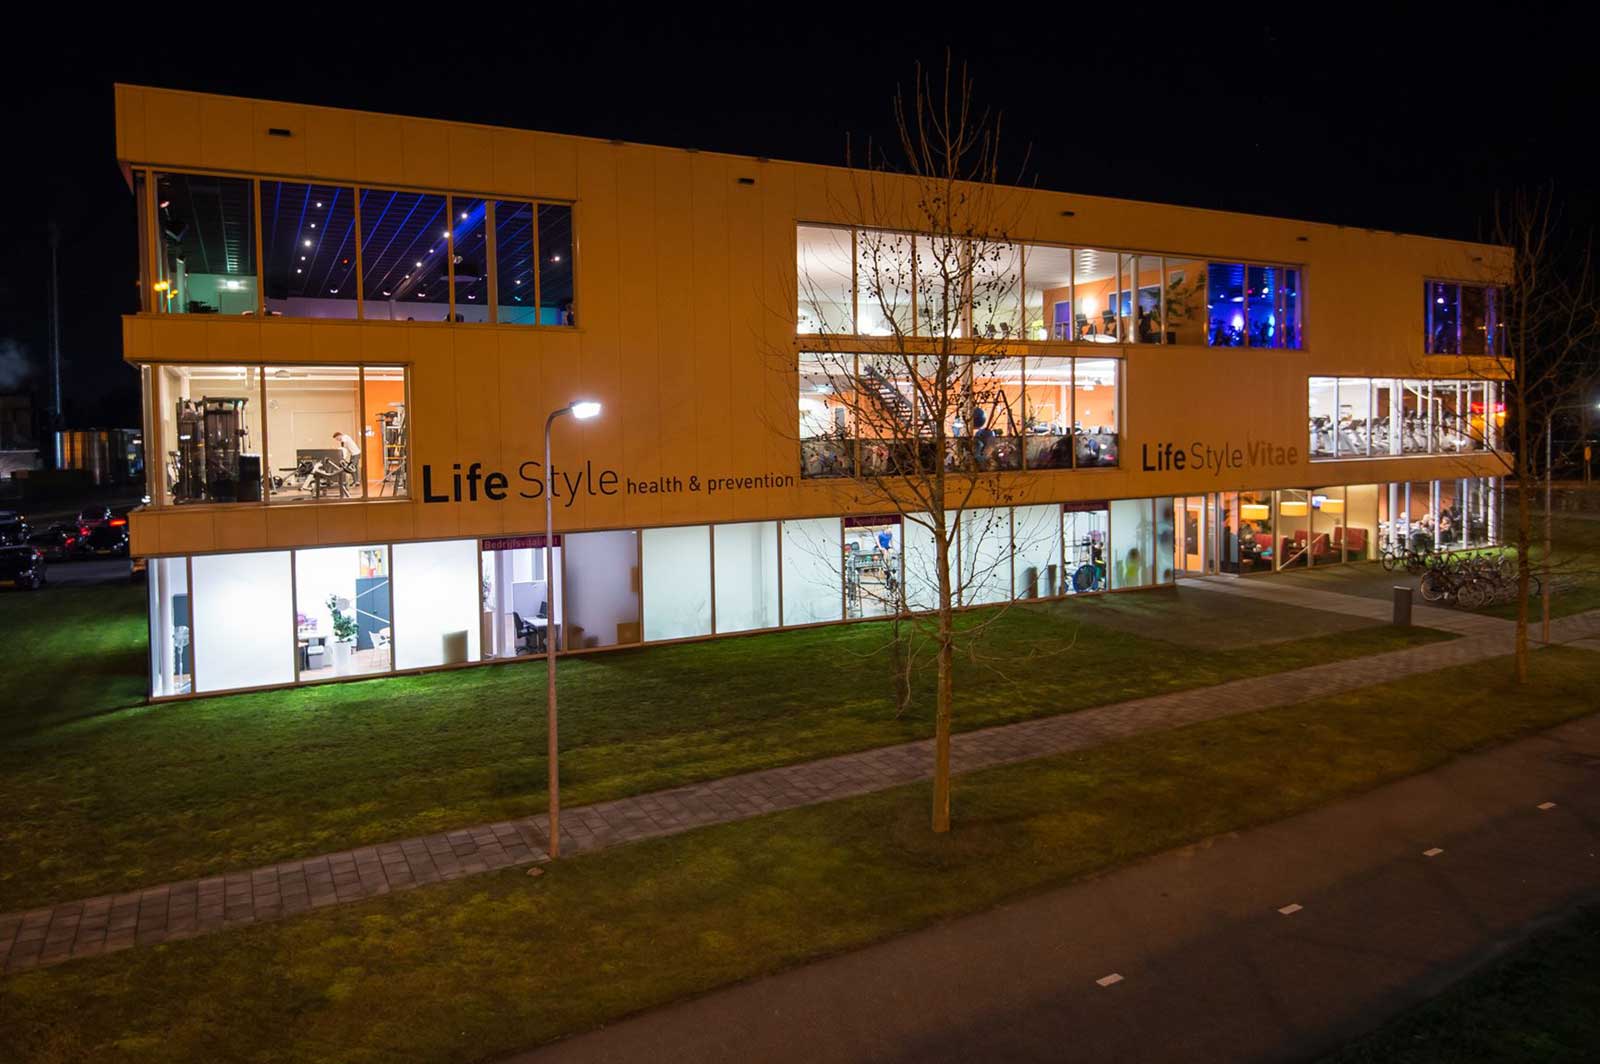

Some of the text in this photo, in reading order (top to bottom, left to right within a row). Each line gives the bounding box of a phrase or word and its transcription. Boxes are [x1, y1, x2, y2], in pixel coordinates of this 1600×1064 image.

[1142, 441, 1298, 476] Life Style Vitae
[422, 460, 794, 507] Life Style health & prevention
